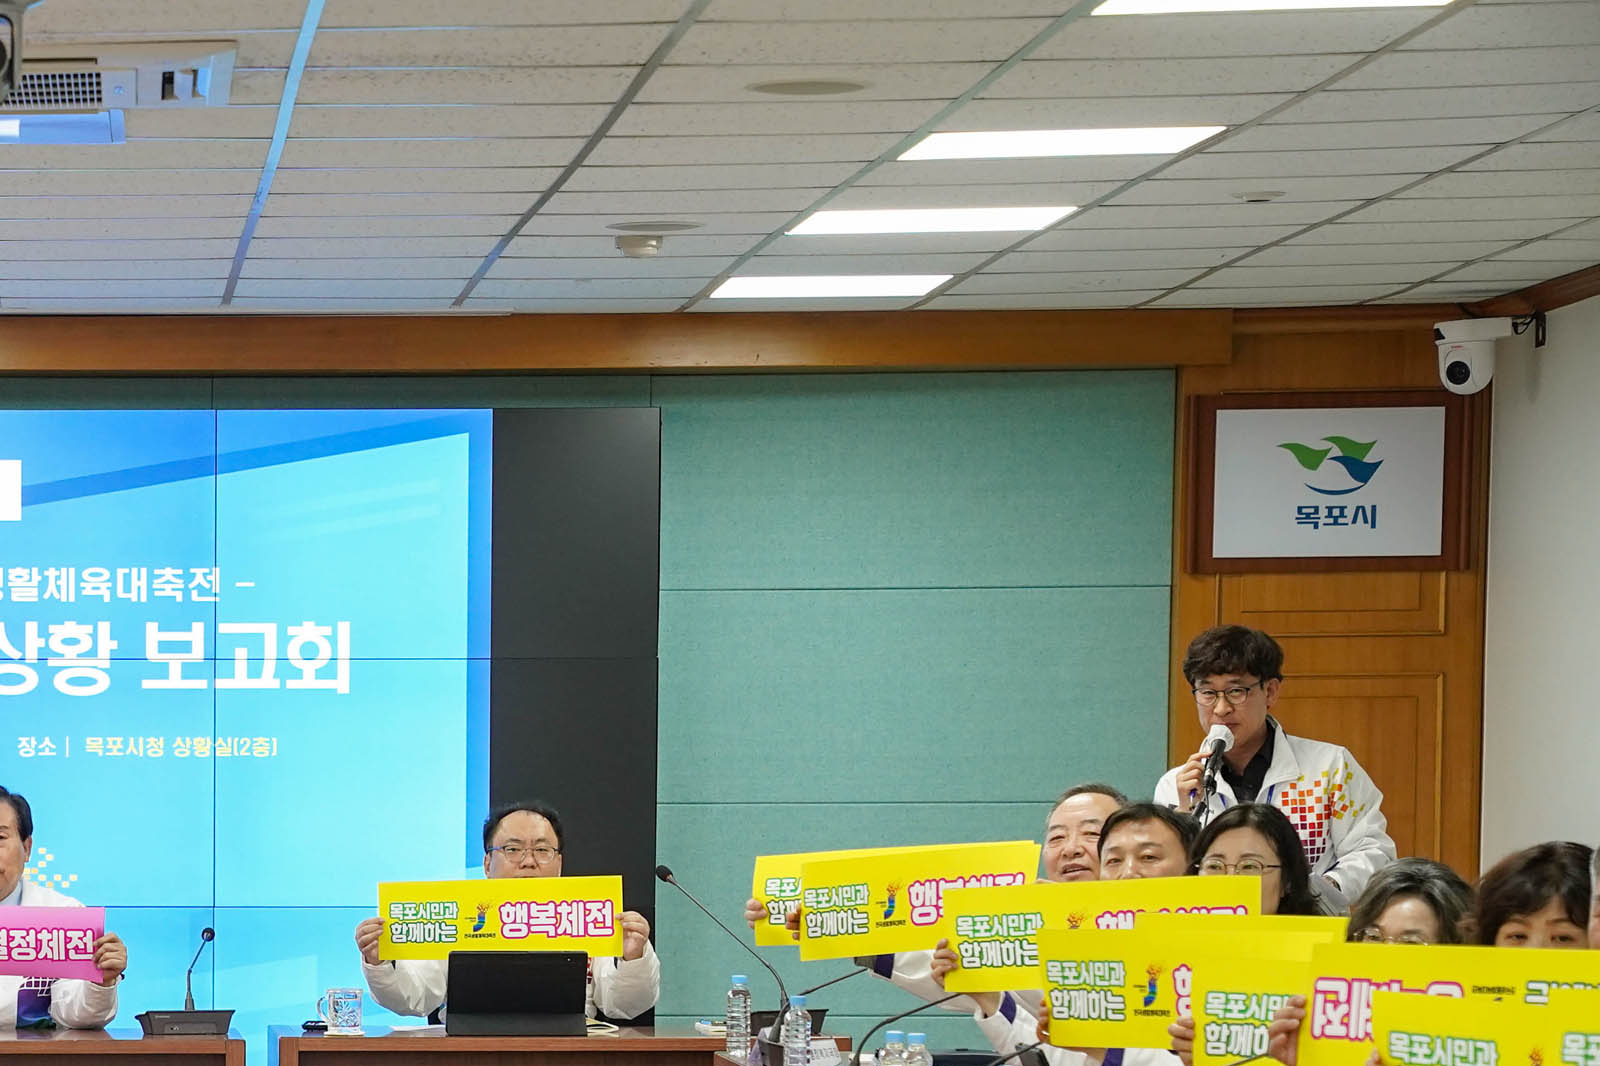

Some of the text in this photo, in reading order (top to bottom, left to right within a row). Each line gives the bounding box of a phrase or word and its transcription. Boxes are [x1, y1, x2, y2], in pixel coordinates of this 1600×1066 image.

[1295, 504, 1377, 530] 목포시
[141, 620, 351, 695] 보고회
[17, 736, 278, 758] 장소 목포시청 상황실(2층)
[804, 883, 870, 909] 목포시민과
[389, 901, 459, 920] 목포시민과
[499, 900, 615, 939] 행복체전
[390, 921, 458, 943] 함께하는
[805, 909, 870, 939] 함께하는
[956, 912, 1045, 938] 목포시민과
[958, 939, 1039, 969] 함께하는
[1046, 960, 1126, 987] 목포시민과
[1049, 988, 1127, 1022] 함께하는
